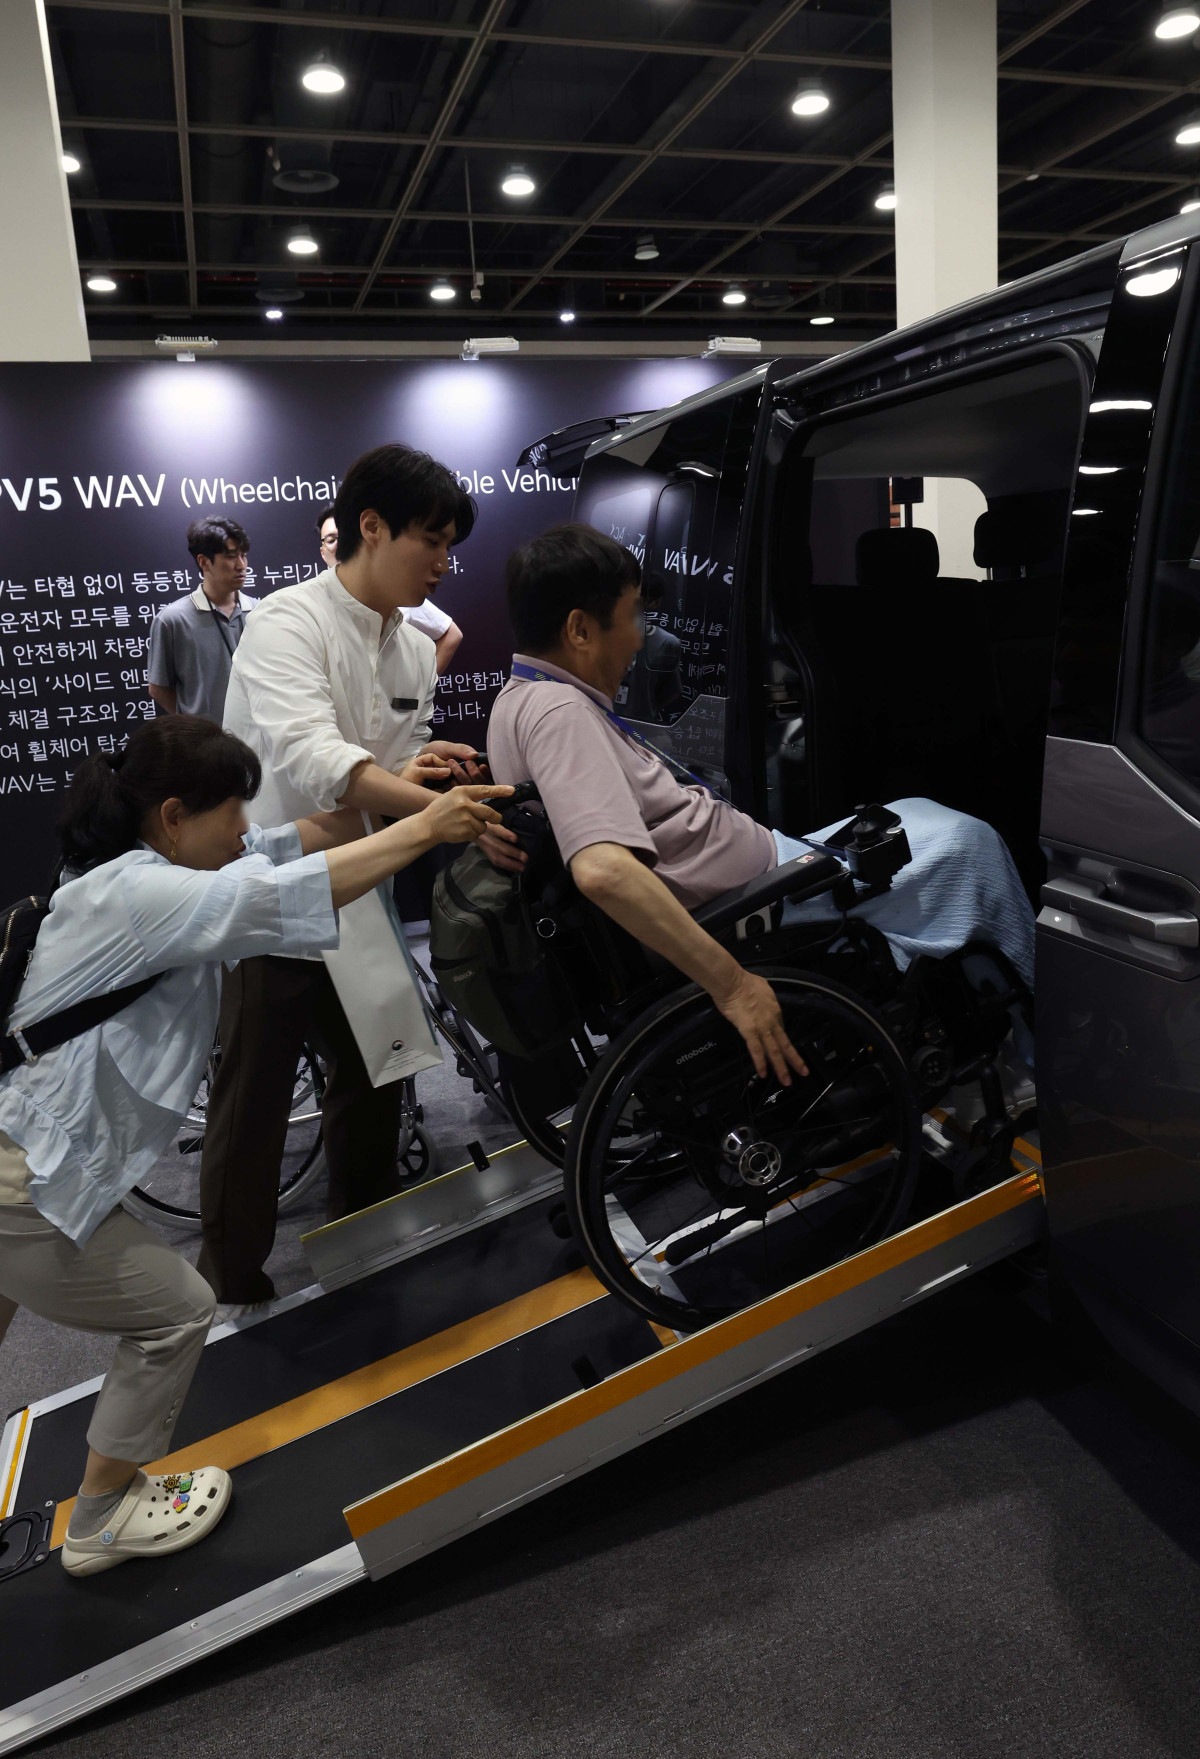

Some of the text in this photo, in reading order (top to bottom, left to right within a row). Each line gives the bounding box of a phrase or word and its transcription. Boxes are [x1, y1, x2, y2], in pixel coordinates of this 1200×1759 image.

[73, 473, 166, 508] WAV
[456, 469, 494, 494] ble
[34, 575, 75, 598] 타협
[83, 572, 124, 595] 없이
[131, 569, 192, 593] 동등한
[0, 610, 62, 634] 운전자
[70, 605, 131, 629] 모두를
[13, 636, 151, 666] 안전하게 차량
[0, 676, 38, 699] 식의
[8, 669, 506, 731] 체결 구조와 2열 편안함과
[27, 737, 90, 762] 휠체어
[432, 699, 486, 724] 습니다.
